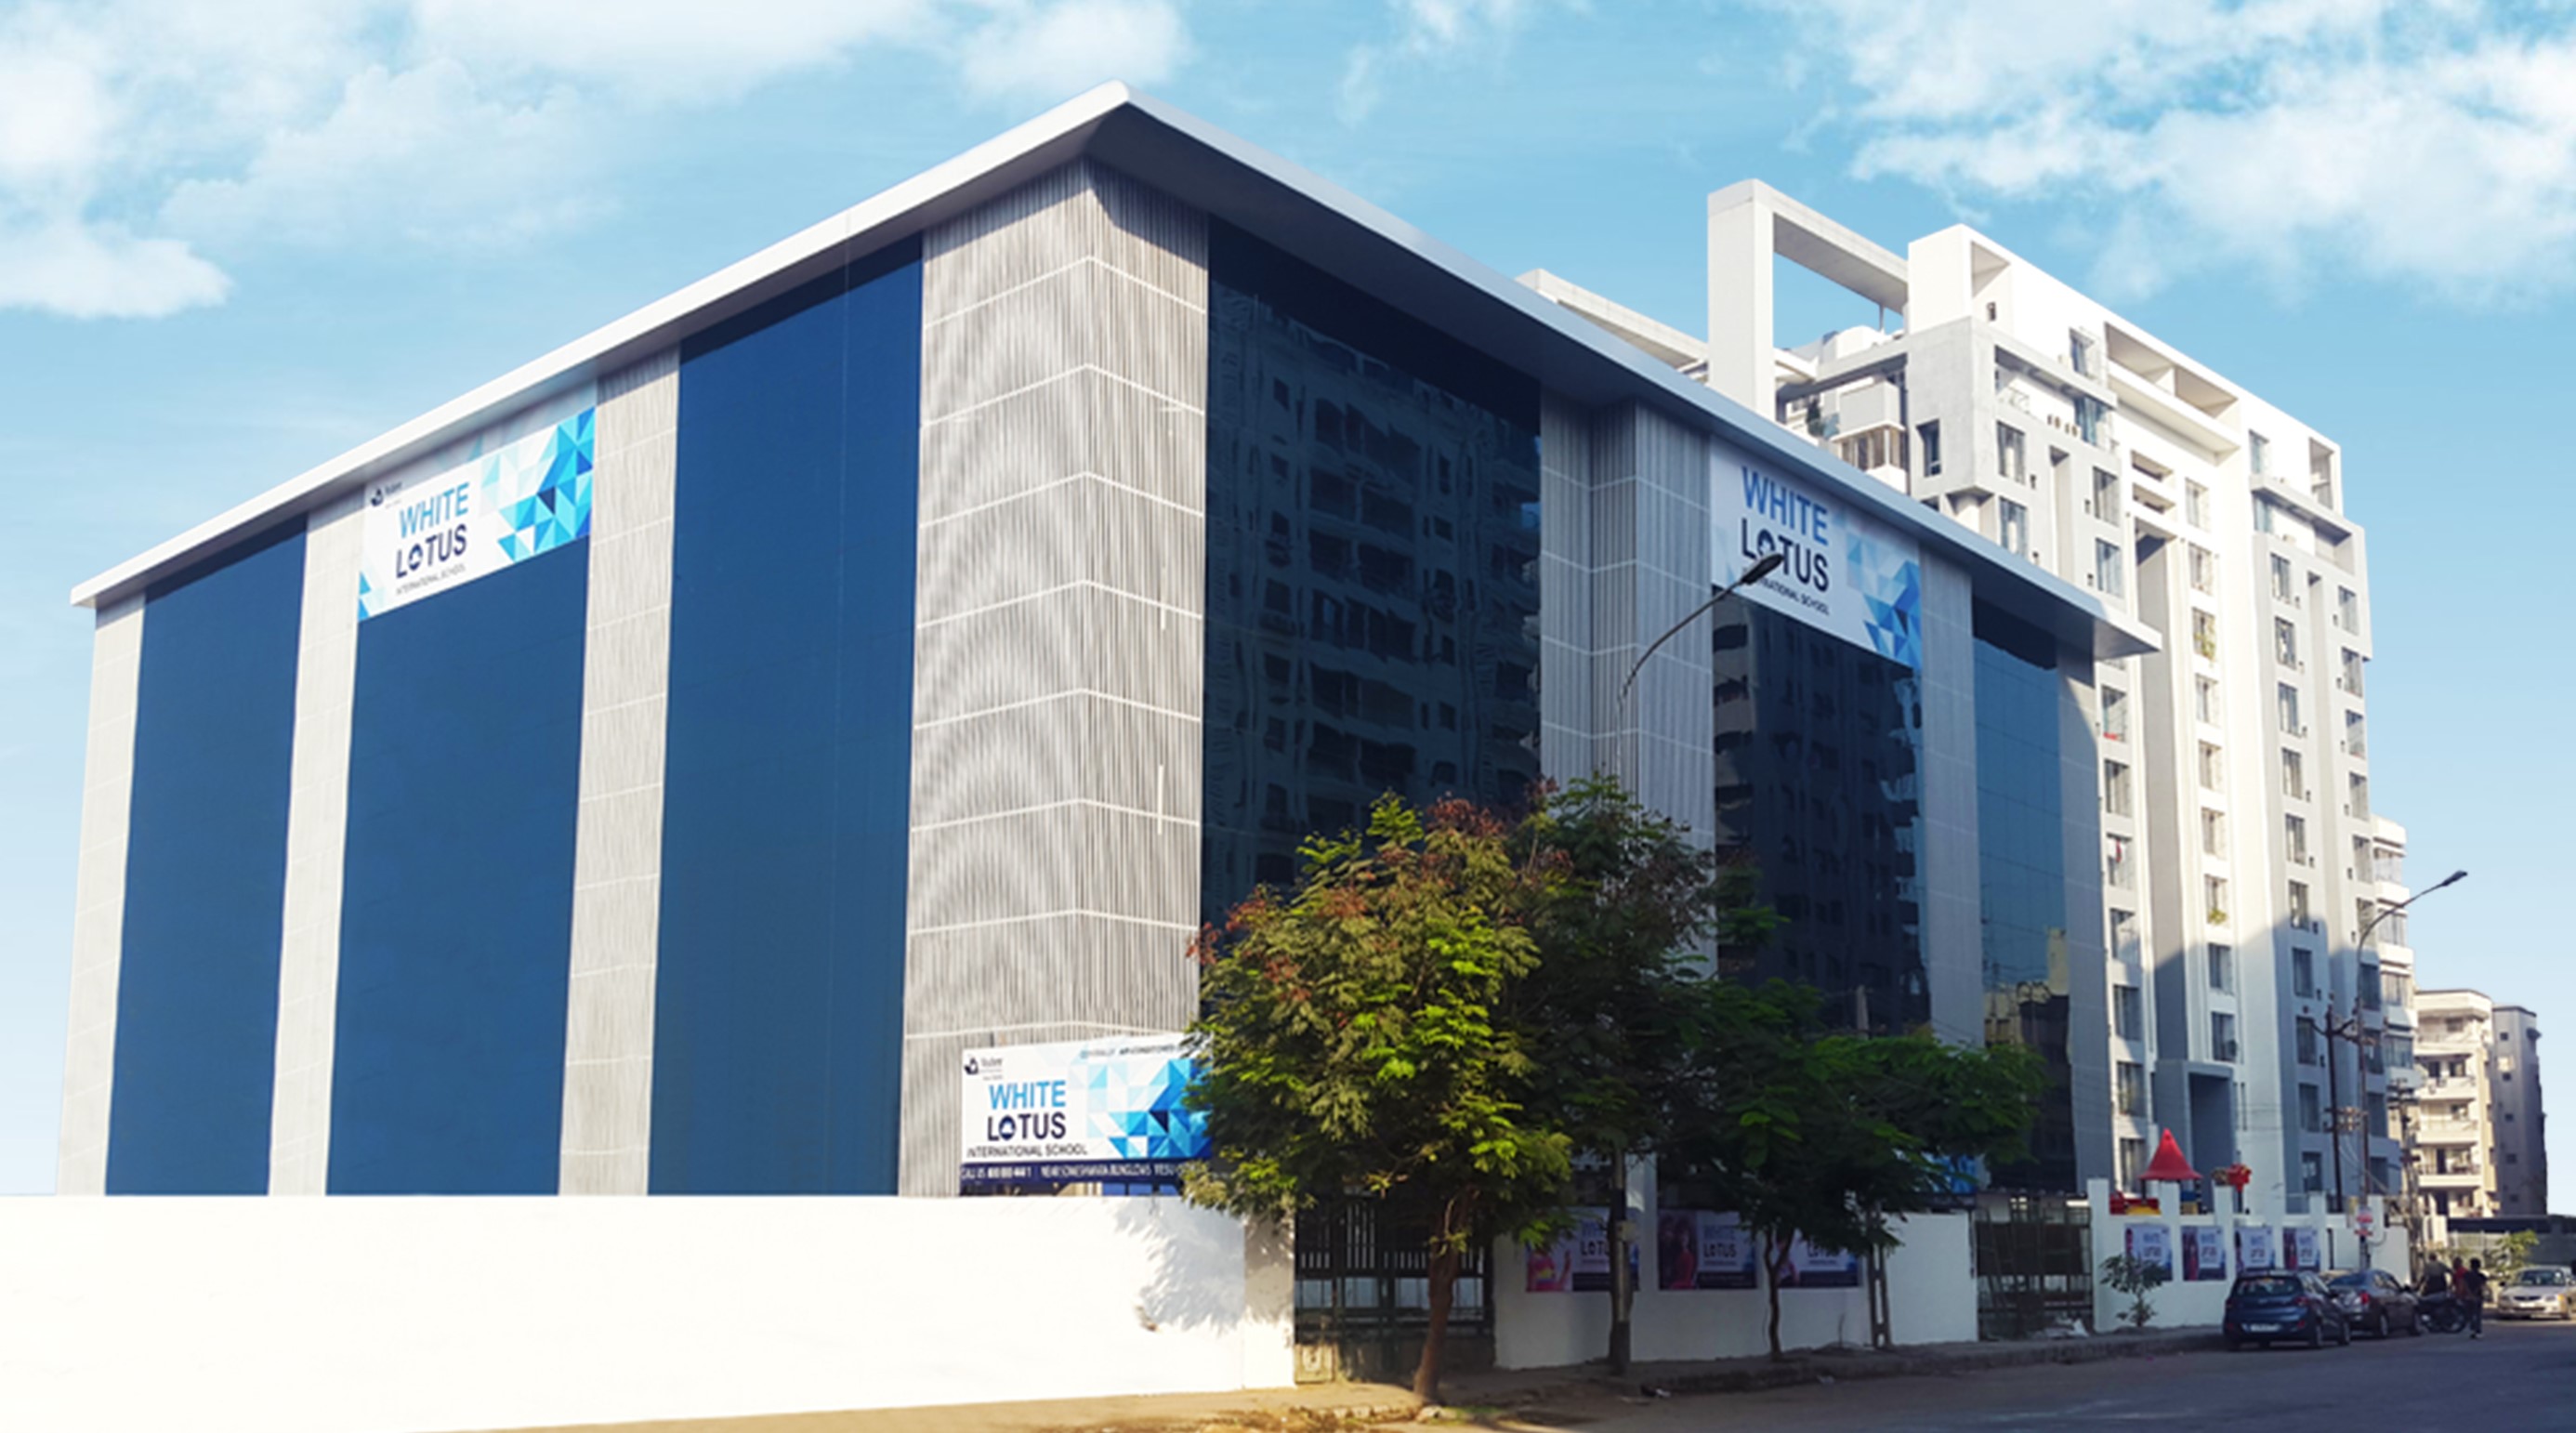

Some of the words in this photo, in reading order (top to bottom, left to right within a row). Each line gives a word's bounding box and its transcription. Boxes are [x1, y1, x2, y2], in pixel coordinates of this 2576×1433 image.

[400, 481, 469, 539] WHITE
[1741, 466, 1830, 546] WHITE
[396, 523, 467, 579] LOTUS
[1741, 518, 1830, 593] LOTUS
[989, 1080, 1067, 1110] WHITE
[987, 1111, 1067, 1141] LOTUS
[966, 1145, 1043, 1158] INTERNATIONAL
[1045, 1143, 1088, 1156] SCHOOL
[1580, 1241, 1610, 1256] LOT
